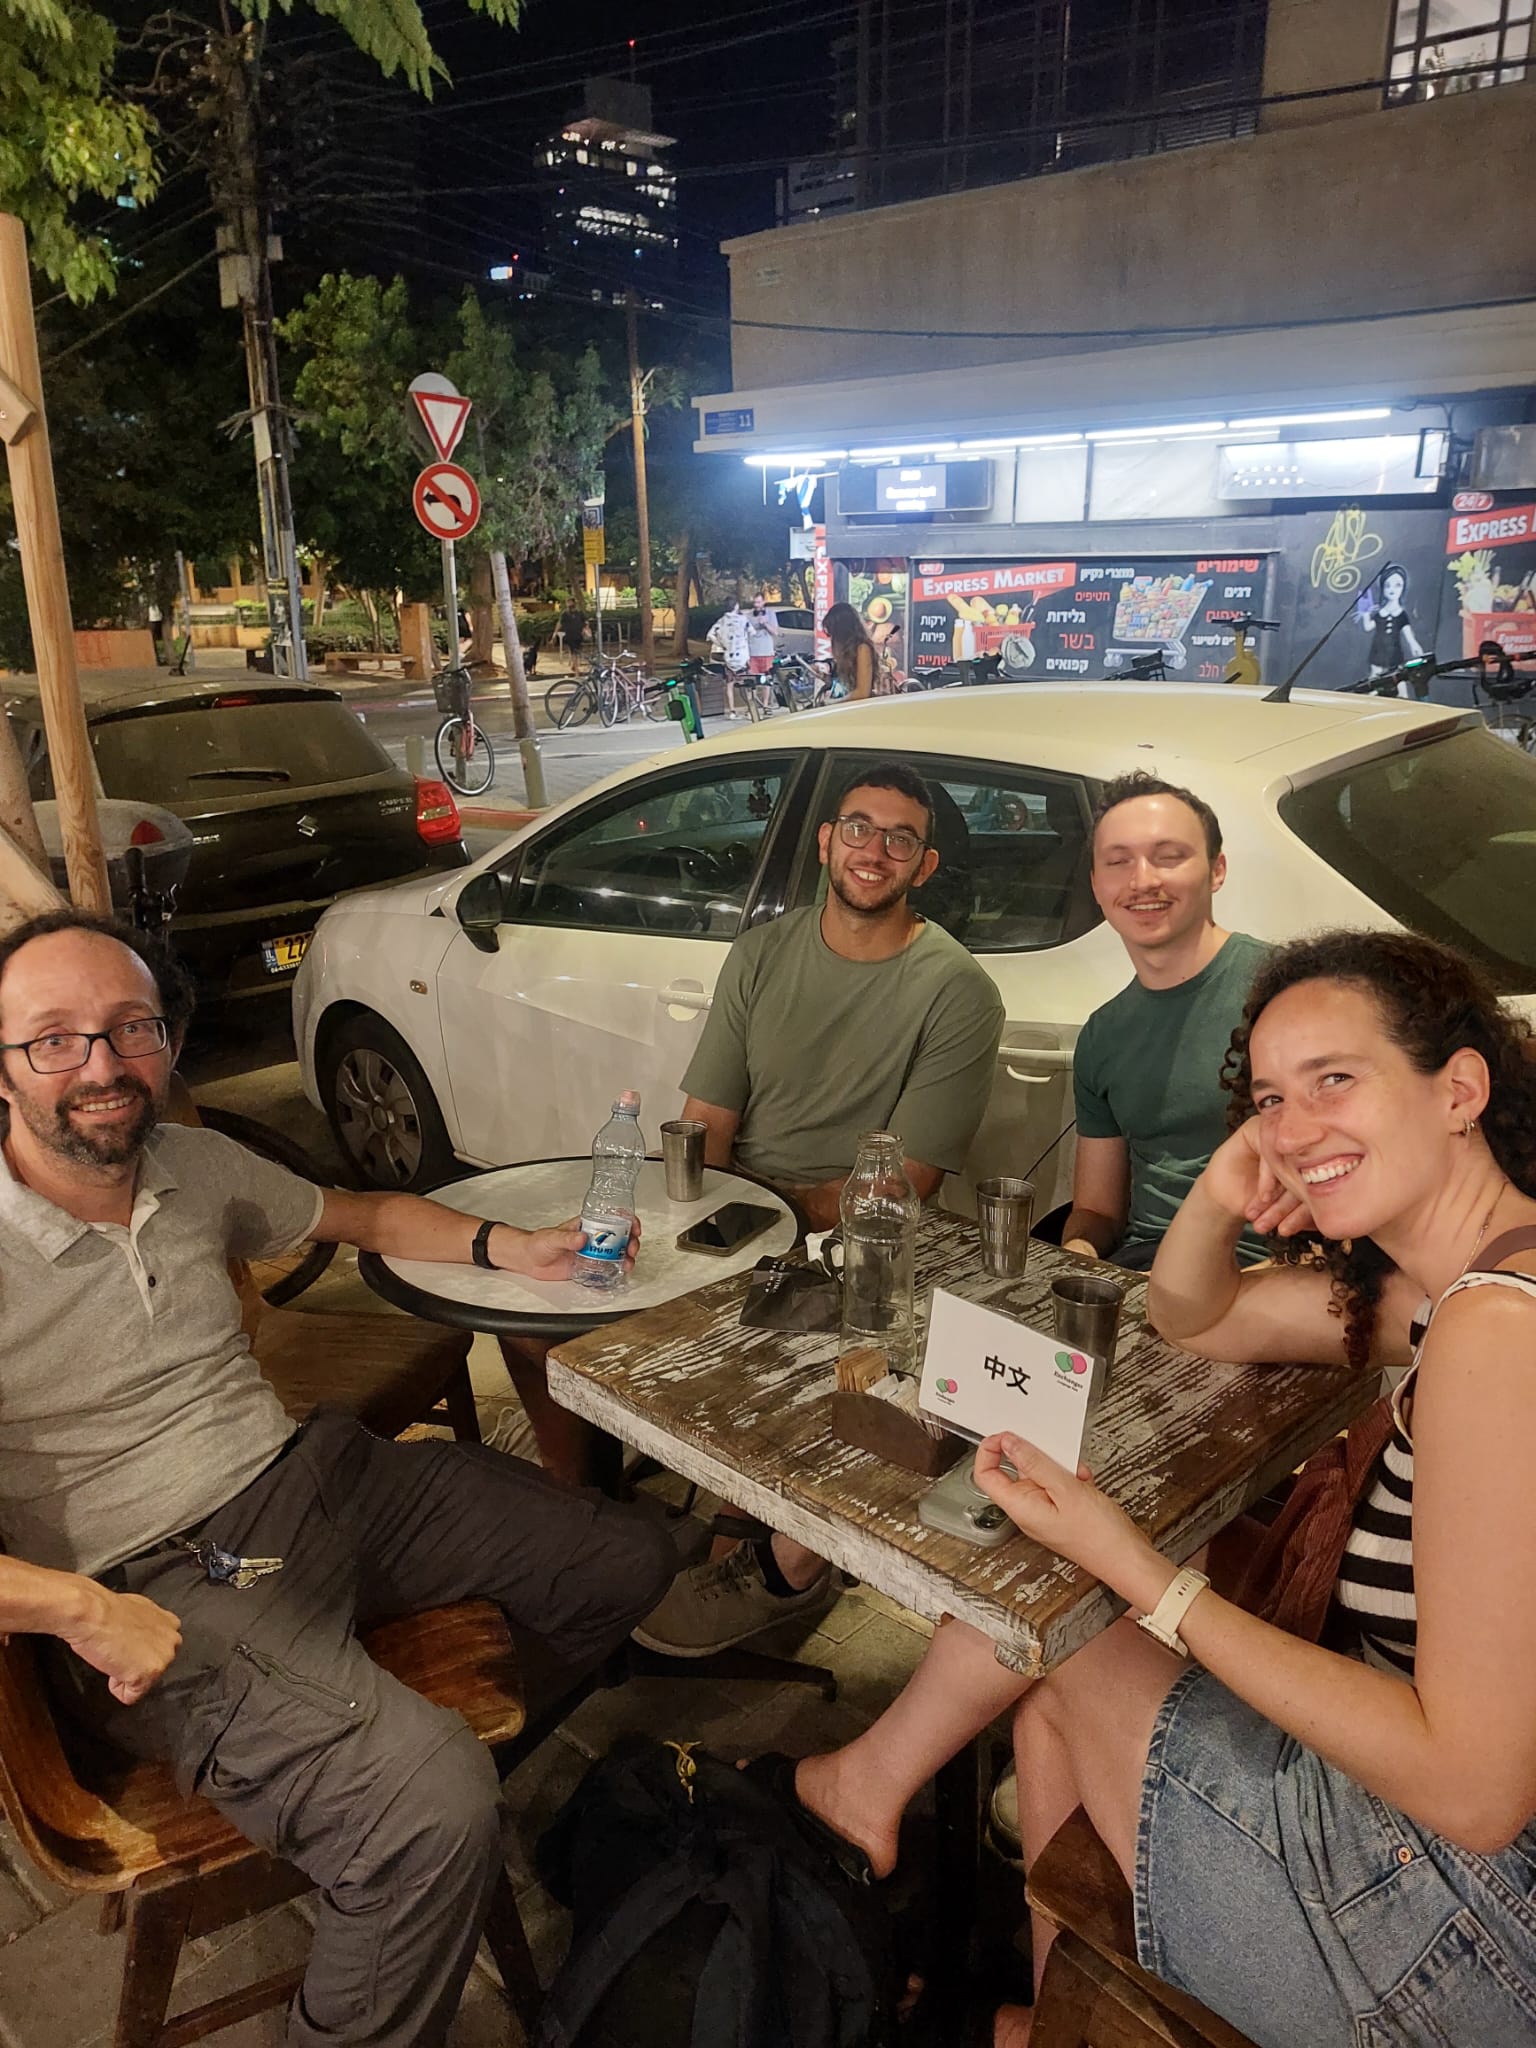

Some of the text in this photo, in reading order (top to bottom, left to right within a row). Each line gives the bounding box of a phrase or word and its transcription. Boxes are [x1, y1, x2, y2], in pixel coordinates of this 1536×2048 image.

[740, 415, 751, 427] 11
[1456, 515, 1528, 545] EXPRESS
[1196, 559, 1259, 574] שימורים
[923, 568, 1066, 597] EXPRESS MARKET
[1075, 591, 1110, 602] חטיפים
[1224, 586, 1252, 598] דגים
[920, 615, 946, 628] ירקות
[1046, 608, 1086, 623] גלידות
[920, 632, 946, 642] פירות
[1059, 633, 1095, 650] בשר
[1046, 658, 1089, 673] קפואים
[1198, 661, 1219, 678] חלב
[984, 1355, 1031, 1396] 中文
